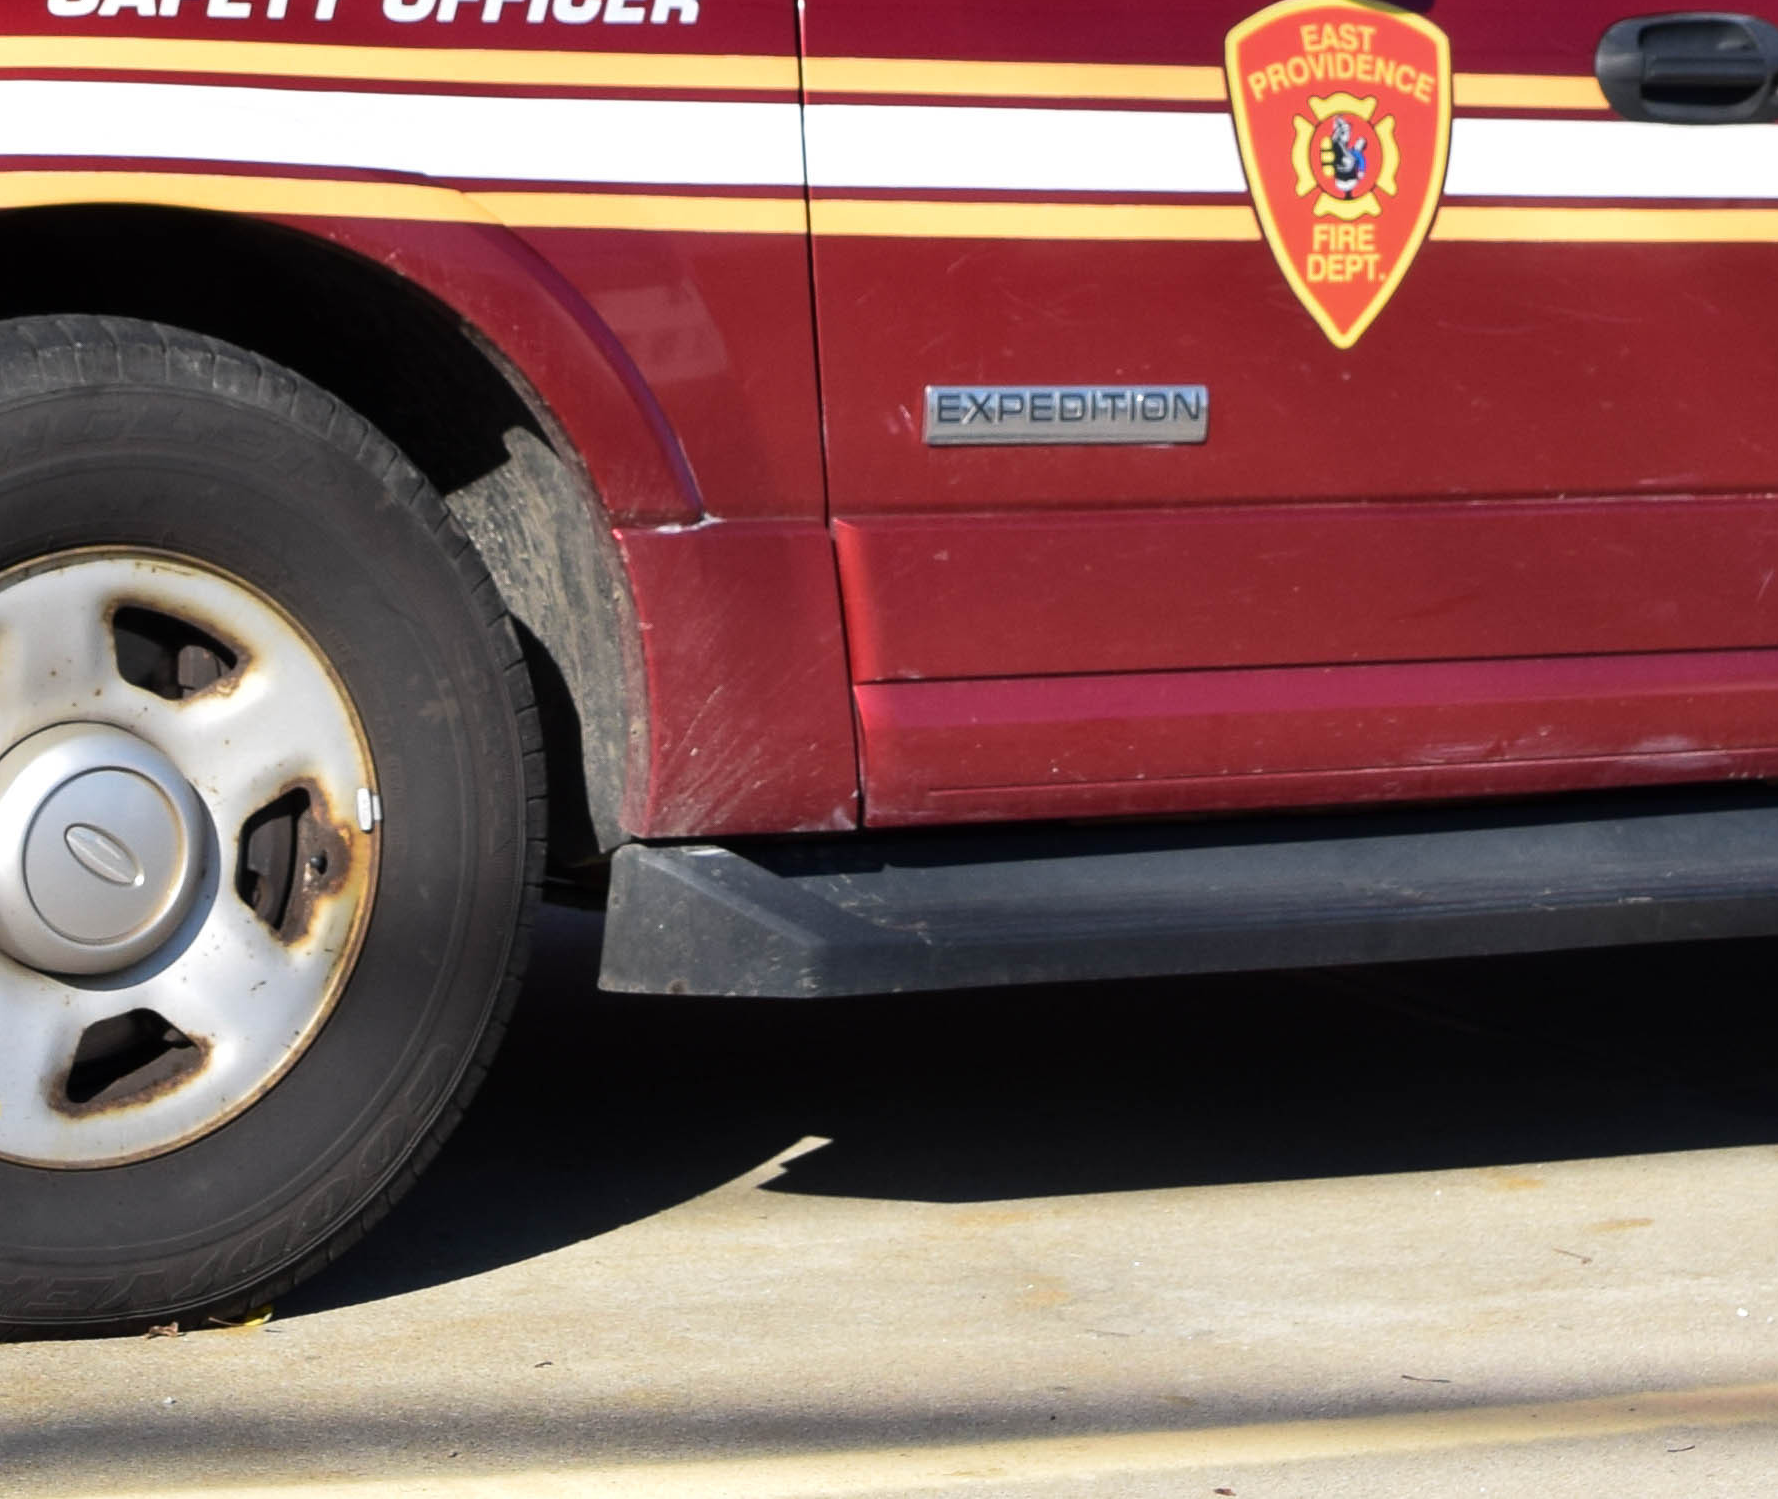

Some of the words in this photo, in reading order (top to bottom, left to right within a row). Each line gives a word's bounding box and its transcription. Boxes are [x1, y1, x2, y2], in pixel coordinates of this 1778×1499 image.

[1299, 23, 1377, 52] EAST
[1247, 53, 1435, 104] PROVIDENCE
[1312, 224, 1375, 252] FIRE
[1306, 254, 1387, 283] DEPT.
[936, 393, 1201, 423] EXPEDITION
